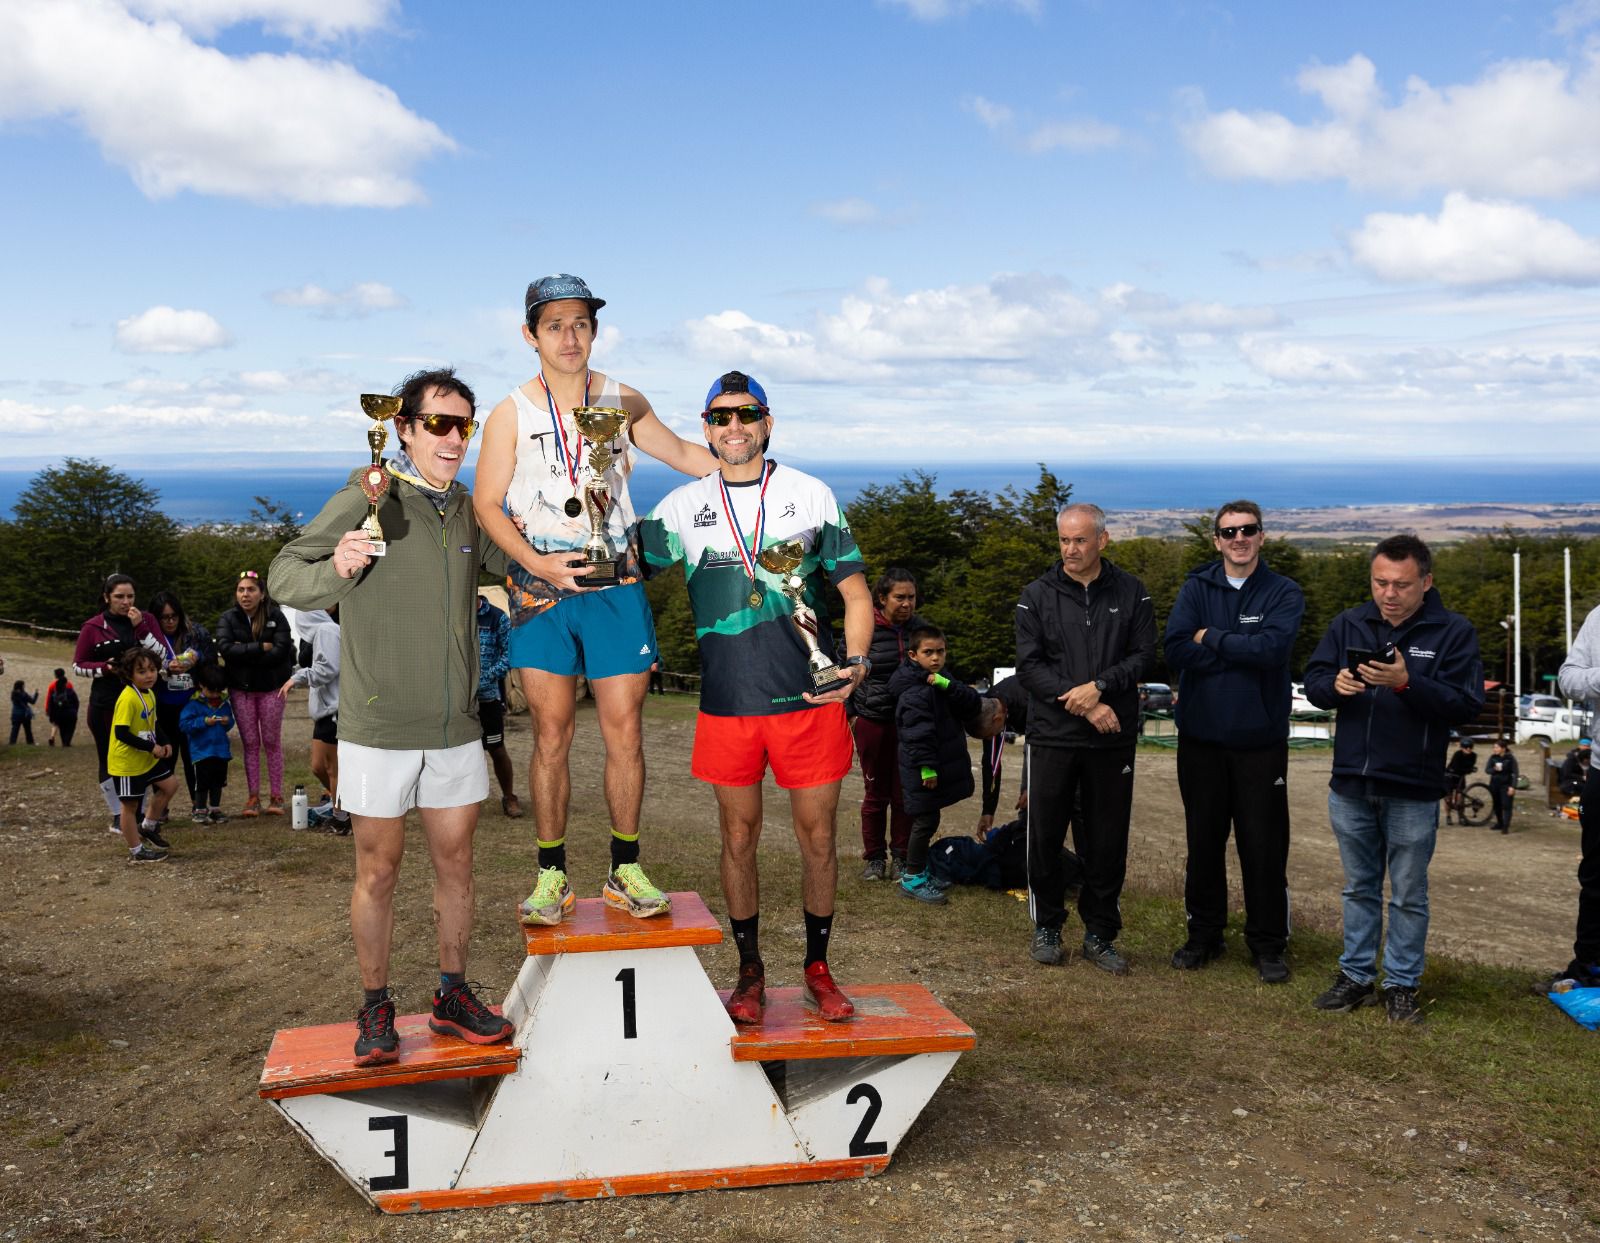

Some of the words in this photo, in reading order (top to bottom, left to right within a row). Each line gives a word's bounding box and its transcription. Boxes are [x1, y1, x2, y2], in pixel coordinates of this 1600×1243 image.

[694, 511, 717, 522] UTMB
[615, 967, 638, 1039] 1
[369, 1115, 409, 1191] 3
[846, 1083, 887, 1157] 2
